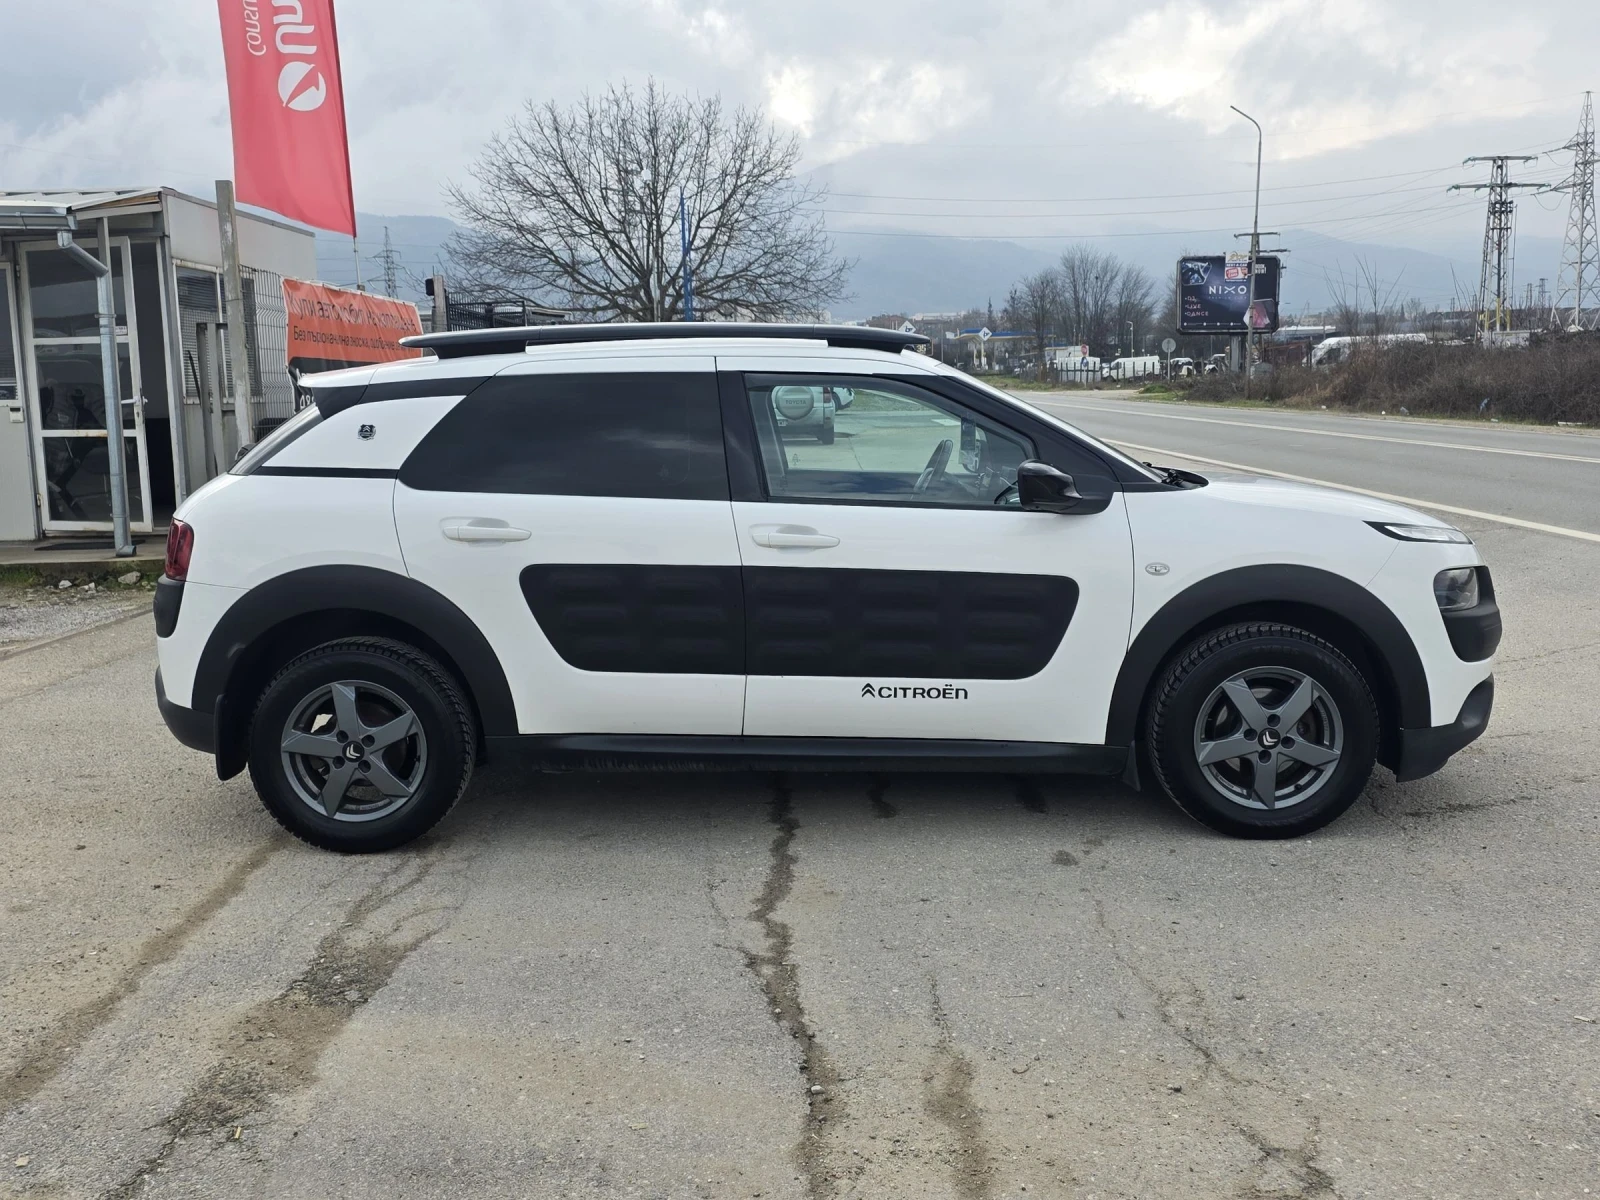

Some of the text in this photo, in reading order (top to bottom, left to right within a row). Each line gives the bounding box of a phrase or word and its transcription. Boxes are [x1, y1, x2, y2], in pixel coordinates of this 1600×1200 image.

[1208, 285, 1247, 294] NIXO
[294, 325, 306, 341] Без
[877, 684, 968, 699] CITROËN
